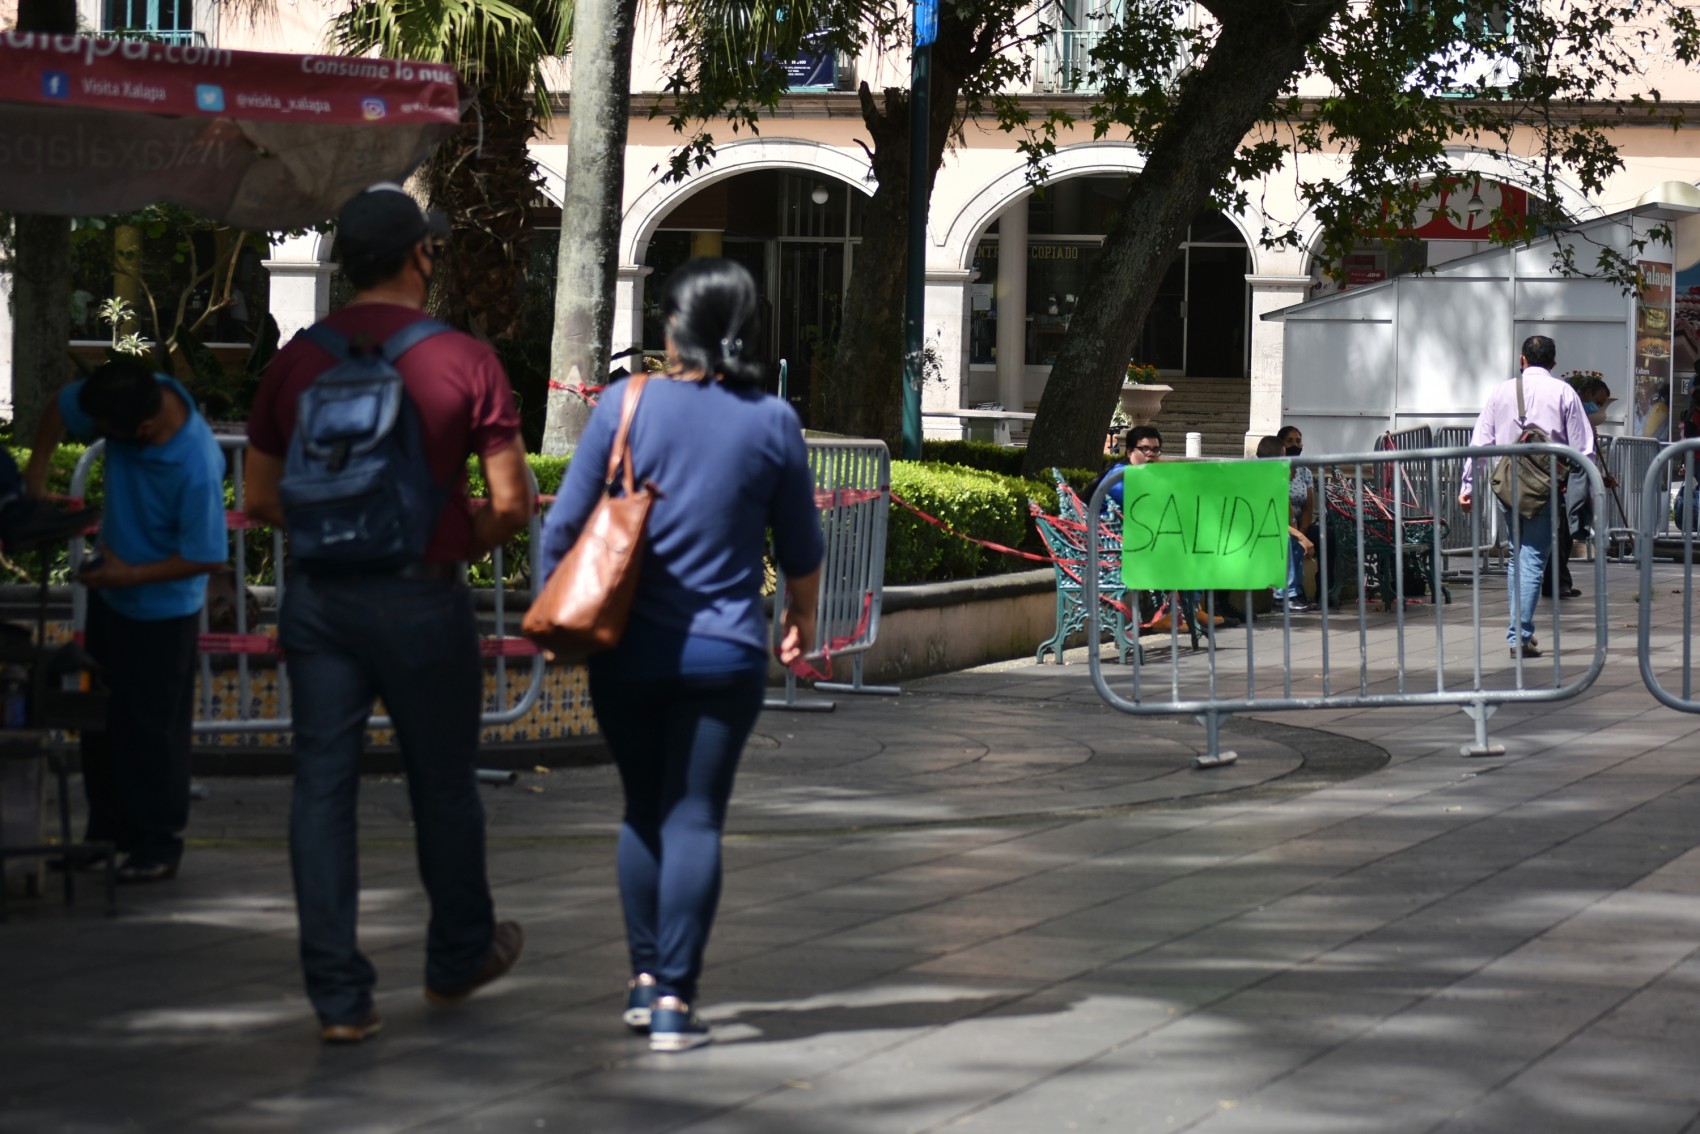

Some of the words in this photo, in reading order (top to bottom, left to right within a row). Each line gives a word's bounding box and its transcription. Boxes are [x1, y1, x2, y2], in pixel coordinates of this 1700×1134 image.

[301, 56, 389, 79] Consume
[395, 59, 413, 80] lo
[82, 78, 119, 96] Visita
[121, 81, 167, 102] Xalapa
[236, 93, 331, 114] @visita_xalapa
[1031, 246, 1078, 259] COPIADO
[1123, 493, 1284, 560] SALIDA
